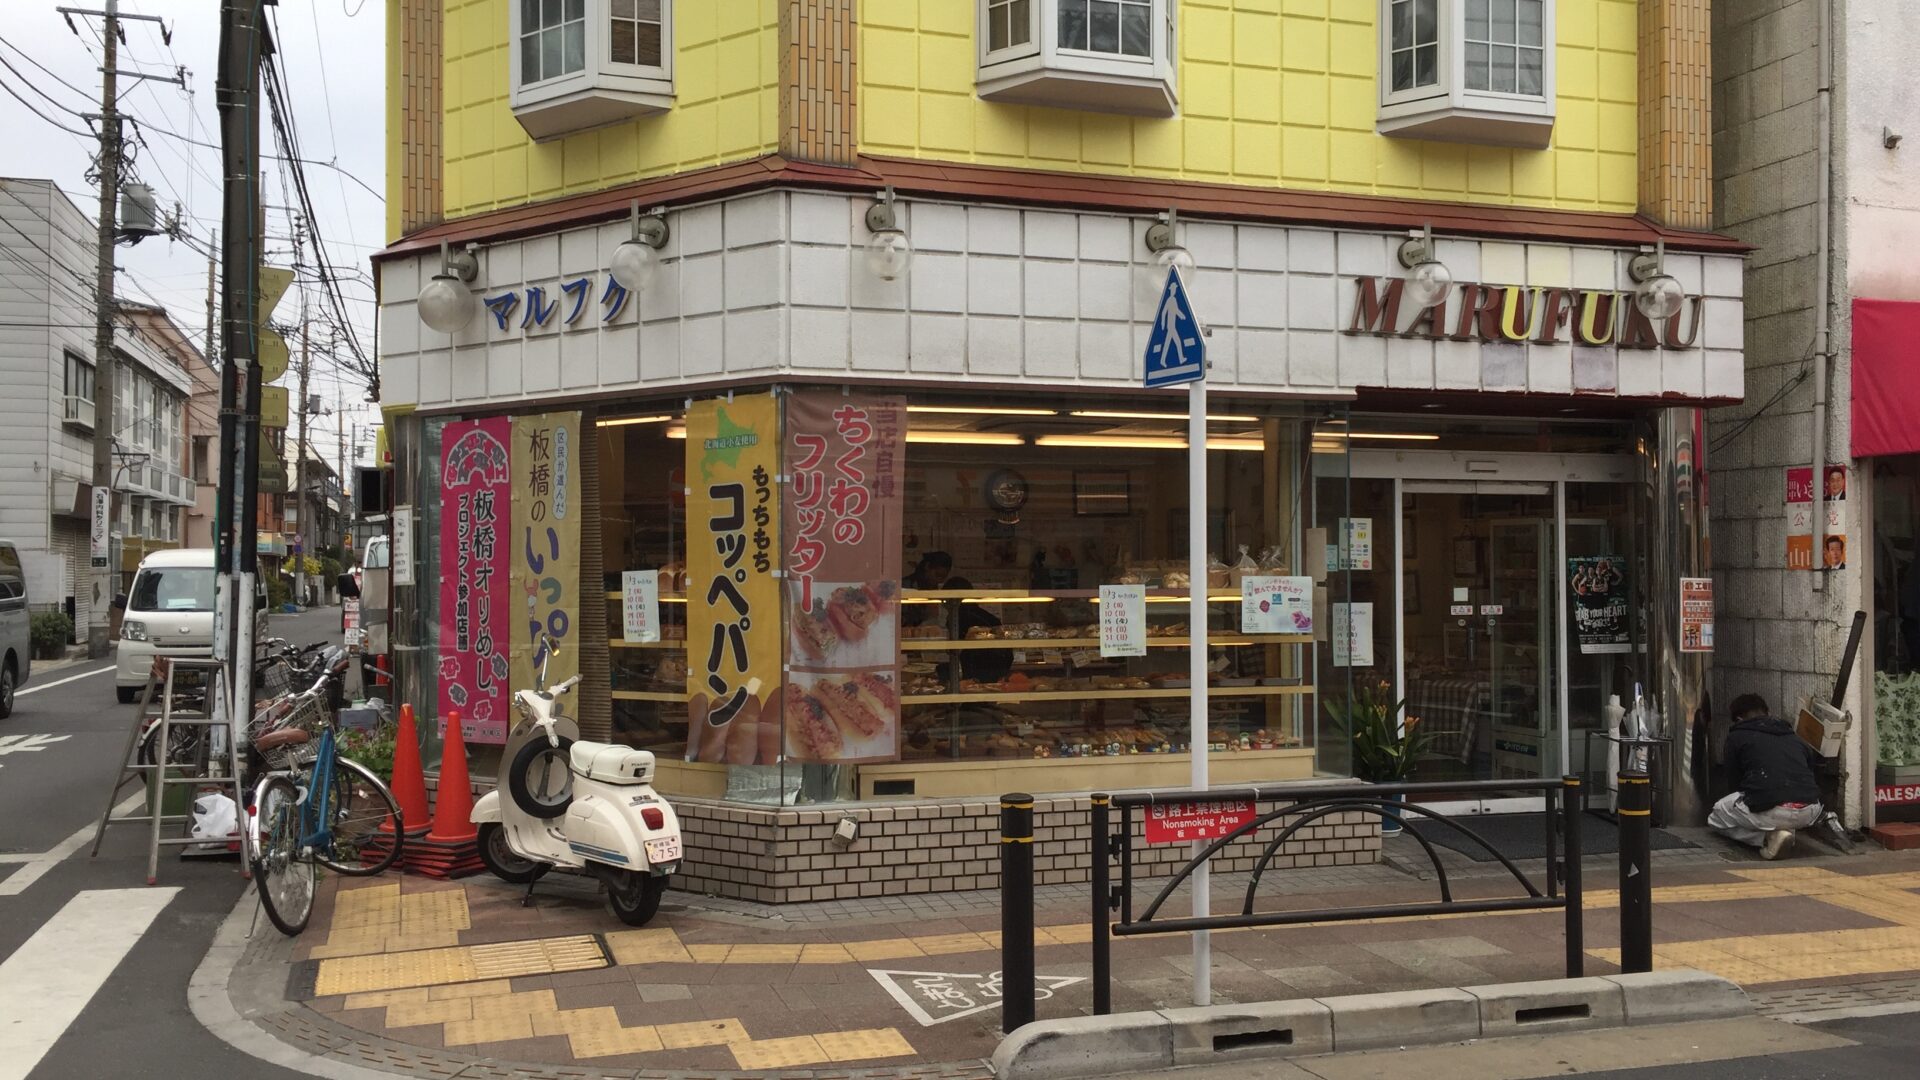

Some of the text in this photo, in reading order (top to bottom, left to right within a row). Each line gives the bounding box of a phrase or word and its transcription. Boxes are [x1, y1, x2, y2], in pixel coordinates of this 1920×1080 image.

[483, 274, 631, 332] マルフク
[1344, 276, 1704, 350] MARUFUKU
[828, 404, 872, 545] ちくわの
[873, 402, 898, 498] 当店自慢
[752, 465, 771, 573] もっちもち
[789, 433, 827, 615] フリッター
[1793, 508, 1840, 526] 公党
[457, 492, 470, 652] プロジェクト参加店舗
[473, 490, 496, 692] 板橋オリめし
[707, 483, 751, 727] コッペパン
[1603, 605, 1628, 617] HEART
[1162, 815, 1239, 829] Nonsmoking Area
[1168, 800, 1249, 818] 路上禁煙地区
[912, 974, 976, 1009] とまれ
